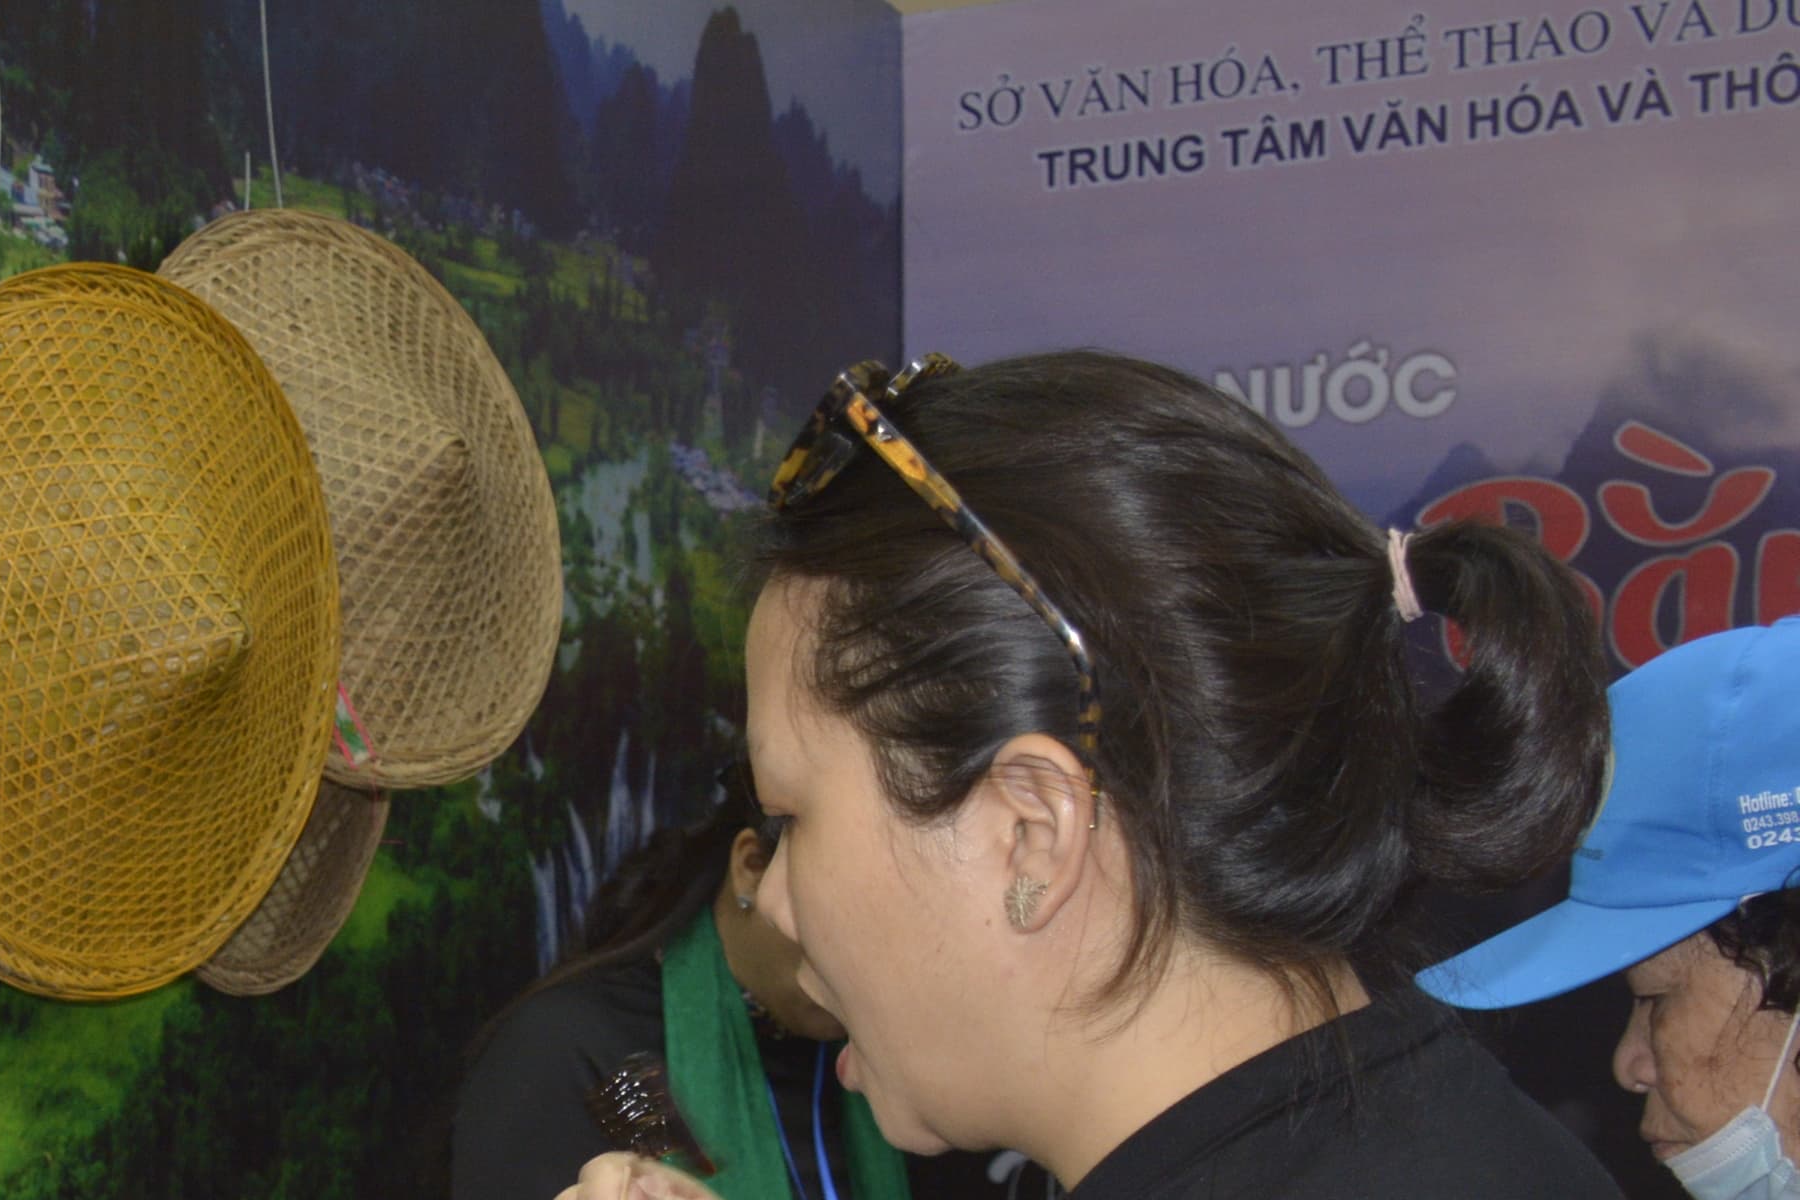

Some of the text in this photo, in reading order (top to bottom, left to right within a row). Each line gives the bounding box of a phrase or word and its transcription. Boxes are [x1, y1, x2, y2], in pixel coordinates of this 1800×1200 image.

[958, 73, 1025, 131] SỞ
[1040, 66, 1151, 118] VĂN
[1170, 46, 1299, 105] HÓA,
[1317, 13, 1428, 86] THỂ
[1444, 11, 1611, 70] THAO
[1038, 134, 1205, 188] TRUNG
[1221, 115, 1326, 167] TÂM
[1343, 101, 1447, 153] VĂN
[1468, 82, 1583, 141] HÓA
[1598, 68, 1672, 123] VÀ
[1740, 791, 1794, 815] Hotline:
